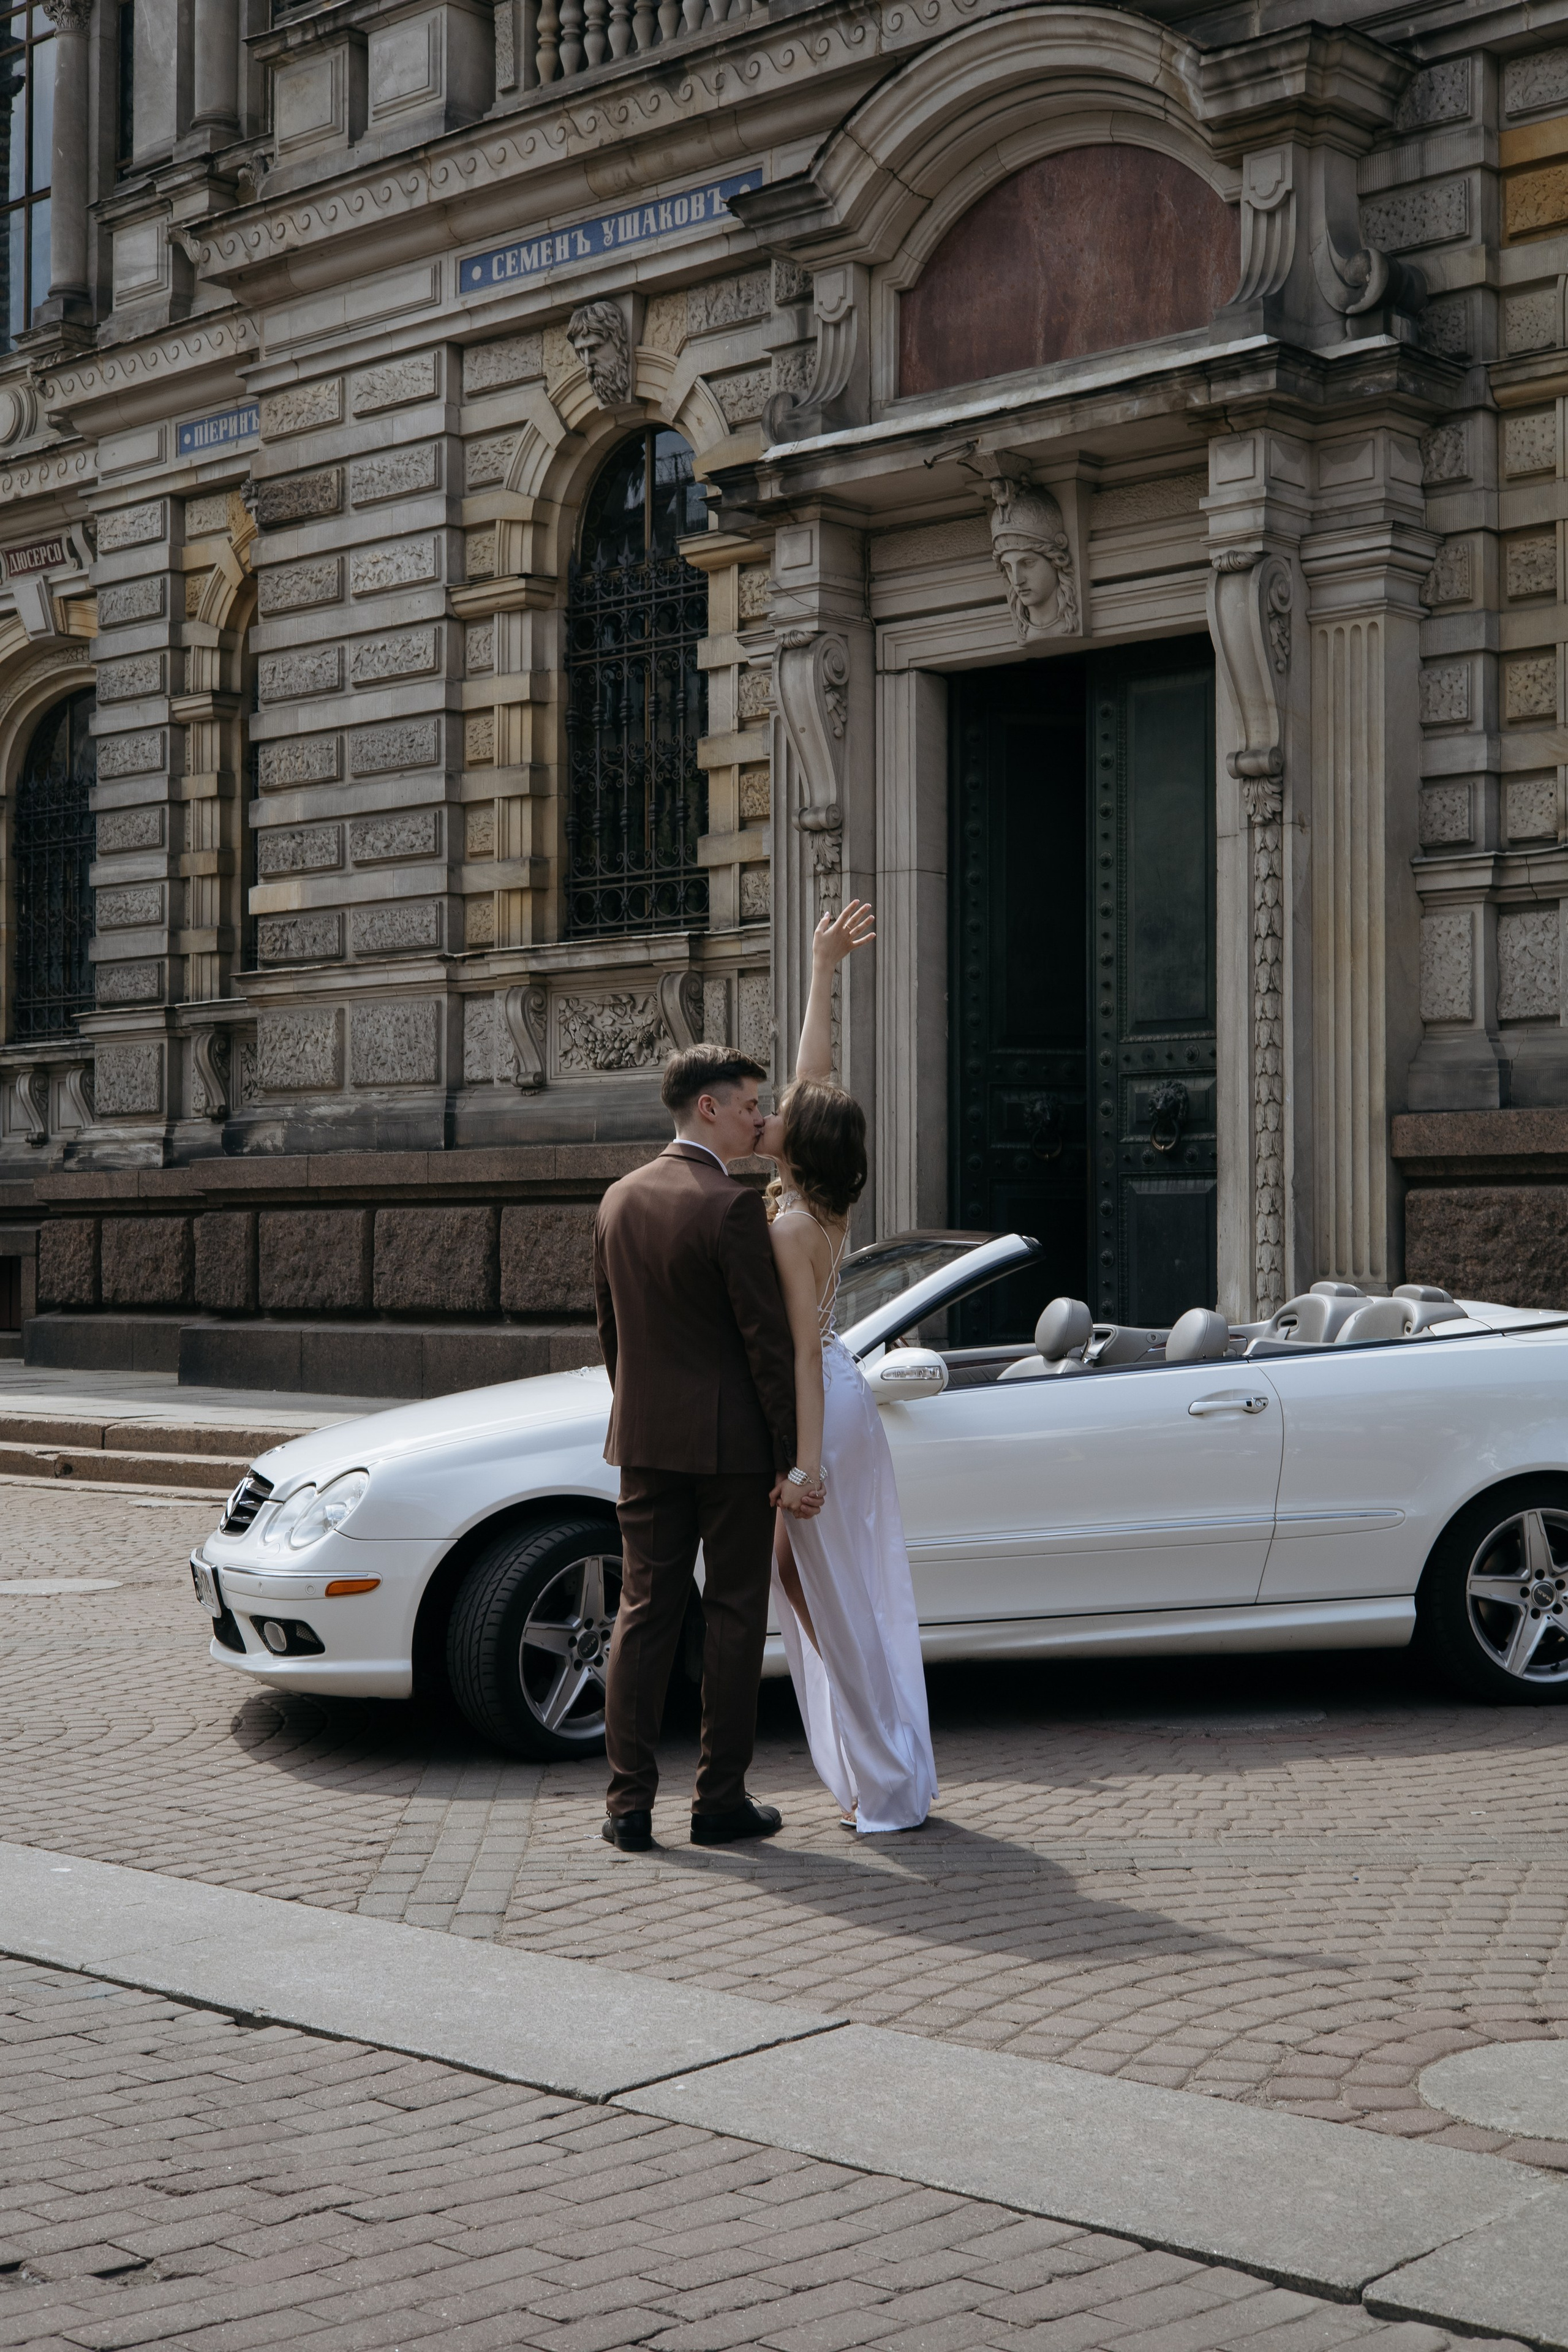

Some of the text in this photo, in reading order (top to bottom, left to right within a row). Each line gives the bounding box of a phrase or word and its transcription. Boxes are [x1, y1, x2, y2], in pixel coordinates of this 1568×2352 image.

[492, 186, 728, 281] СЕМЕНЪ УШАКОВЪ
[9, 543, 62, 574] ДЮСЕРСО
